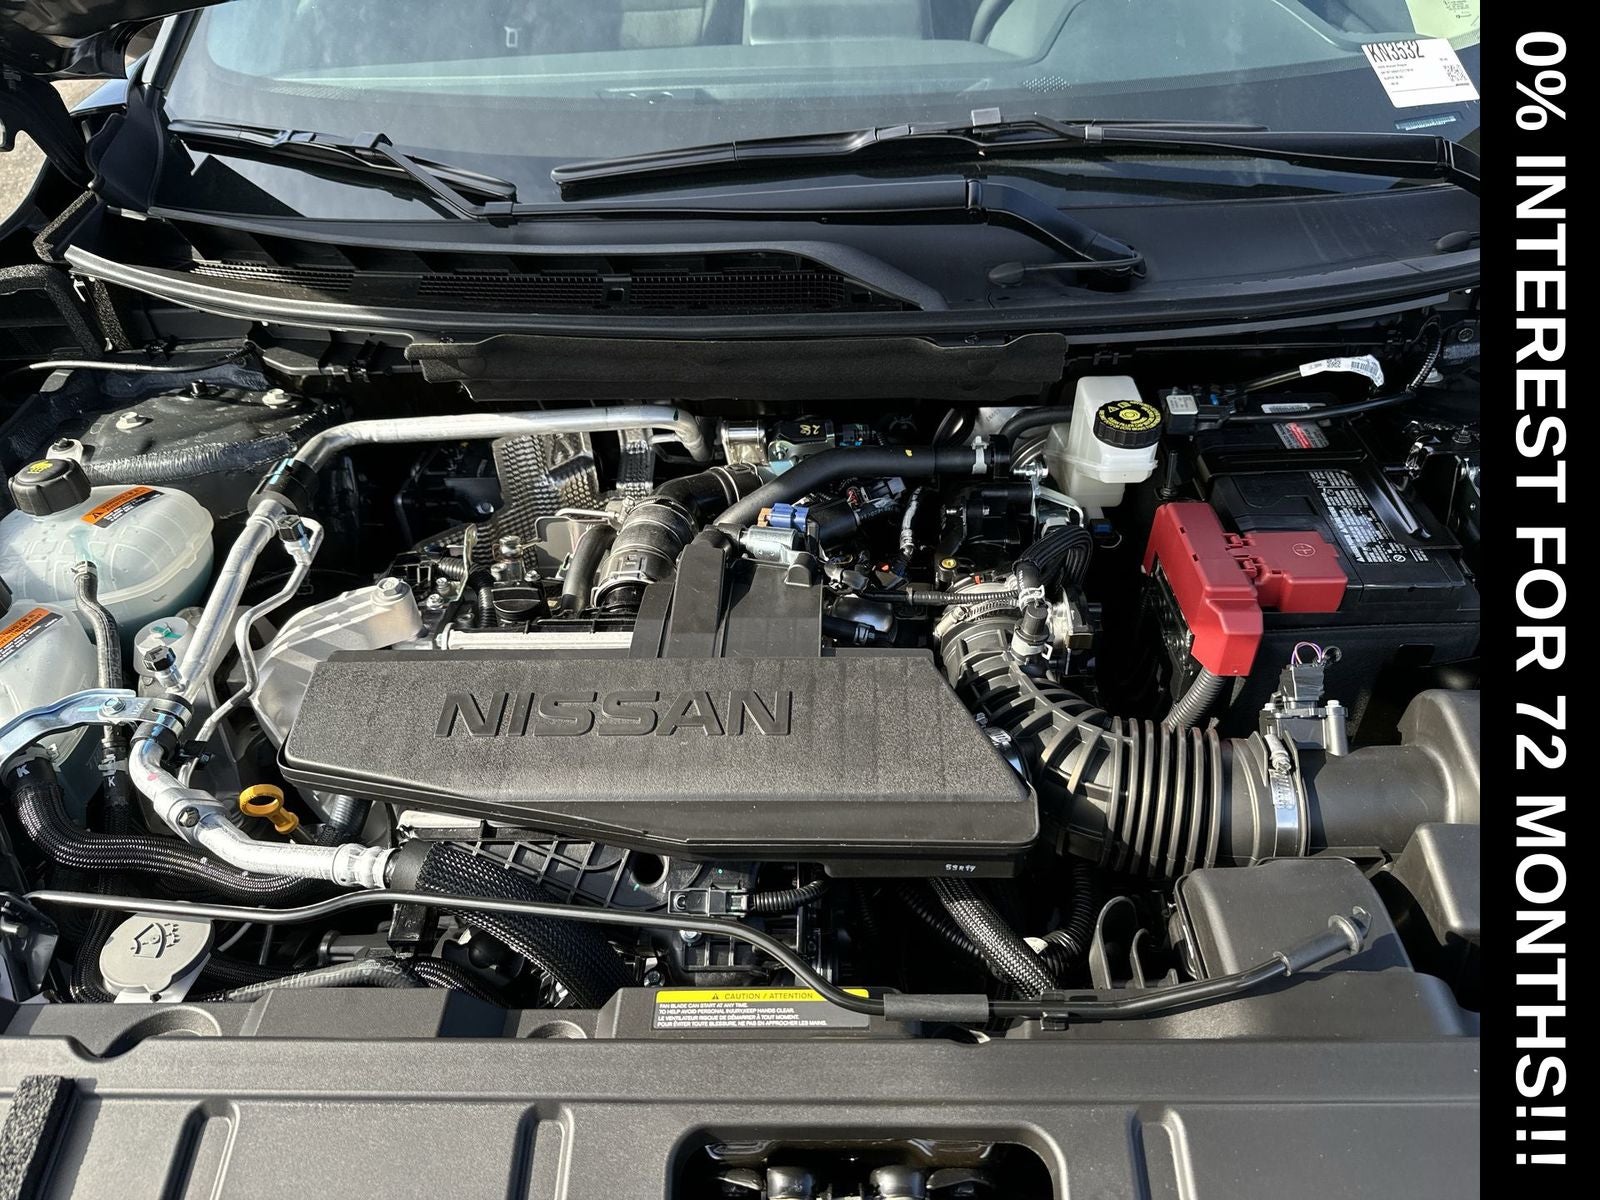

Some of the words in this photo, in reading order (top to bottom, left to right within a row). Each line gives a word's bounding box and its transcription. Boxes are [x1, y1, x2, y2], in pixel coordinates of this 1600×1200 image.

[1367, 40, 1425, 62] KN3532
[435, 691, 793, 736] NISSAN
[16, 764, 30, 778] K
[107, 776, 116, 787] K
